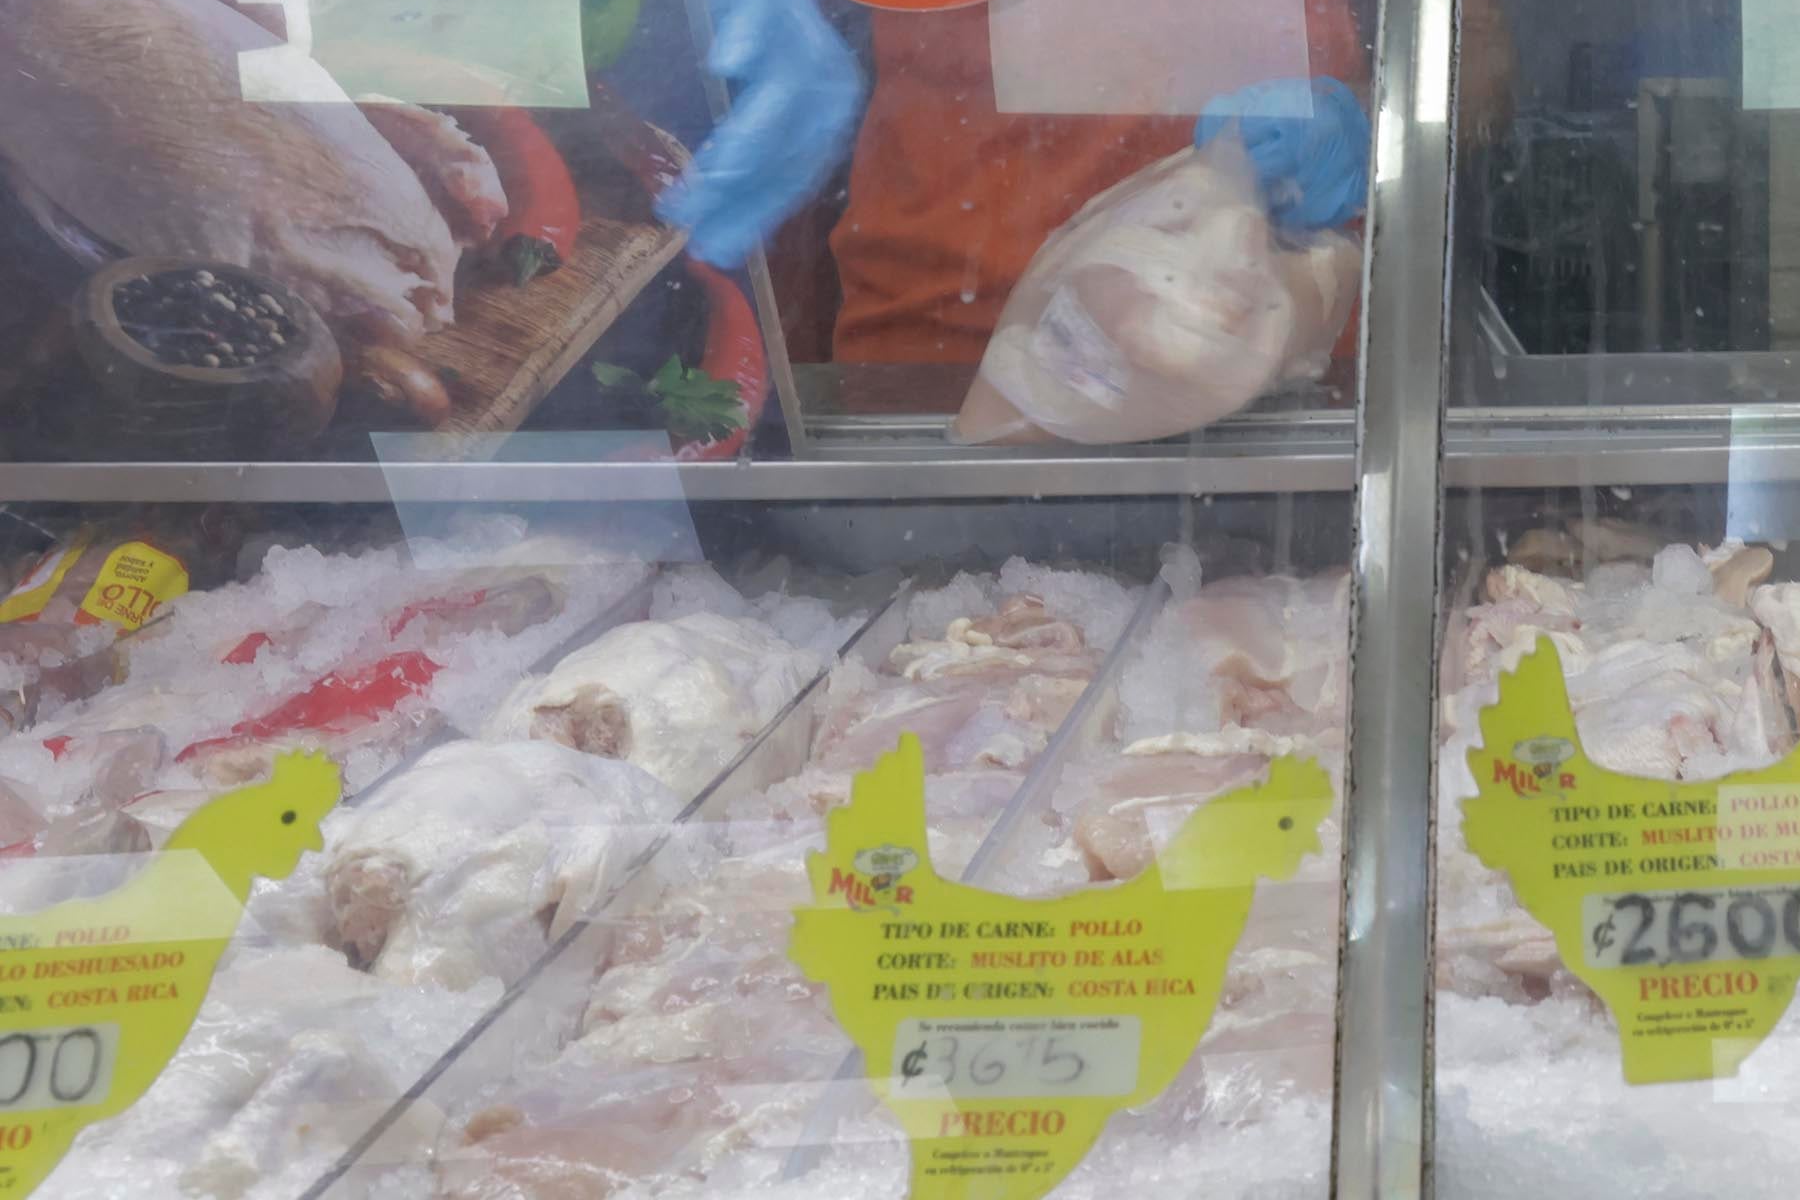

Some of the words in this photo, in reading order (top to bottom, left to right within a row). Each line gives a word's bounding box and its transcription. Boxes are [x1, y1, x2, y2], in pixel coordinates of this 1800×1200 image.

[102, 584, 161, 618] LLO
[1552, 805, 1599, 822] TIPO
[1607, 804, 1635, 820] DE
[1643, 800, 1717, 817] CARNE:
[1731, 794, 1799, 813] POLLO
[1552, 831, 1628, 850] CORTE:
[1642, 824, 1732, 845] MUSLITO
[1740, 822, 1768, 839] DE
[1553, 861, 1597, 879] PAIS
[1604, 859, 1633, 875] DE
[1639, 854, 1725, 874] ORIGEN:
[55, 926, 130, 946] POLLO
[881, 922, 932, 940] TIPO
[939, 922, 969, 939] DE
[976, 921, 1055, 939] CARNE:
[1070, 919, 1143, 937] POLLO
[33, 951, 185, 979] DESHUESADO
[877, 952, 956, 970] CORTE:
[971, 950, 1067, 969] MUSLITO
[1073, 949, 1104, 968] DE
[1111, 948, 1164, 966] ALAS
[47, 988, 118, 1009] COSTA
[125, 982, 179, 1004] RICA
[872, 983, 919, 1000] PAIS
[1067, 979, 1137, 998] COSTA
[1639, 970, 1759, 1002] PRECIO
[939, 1109, 1066, 1137] PRECIO
